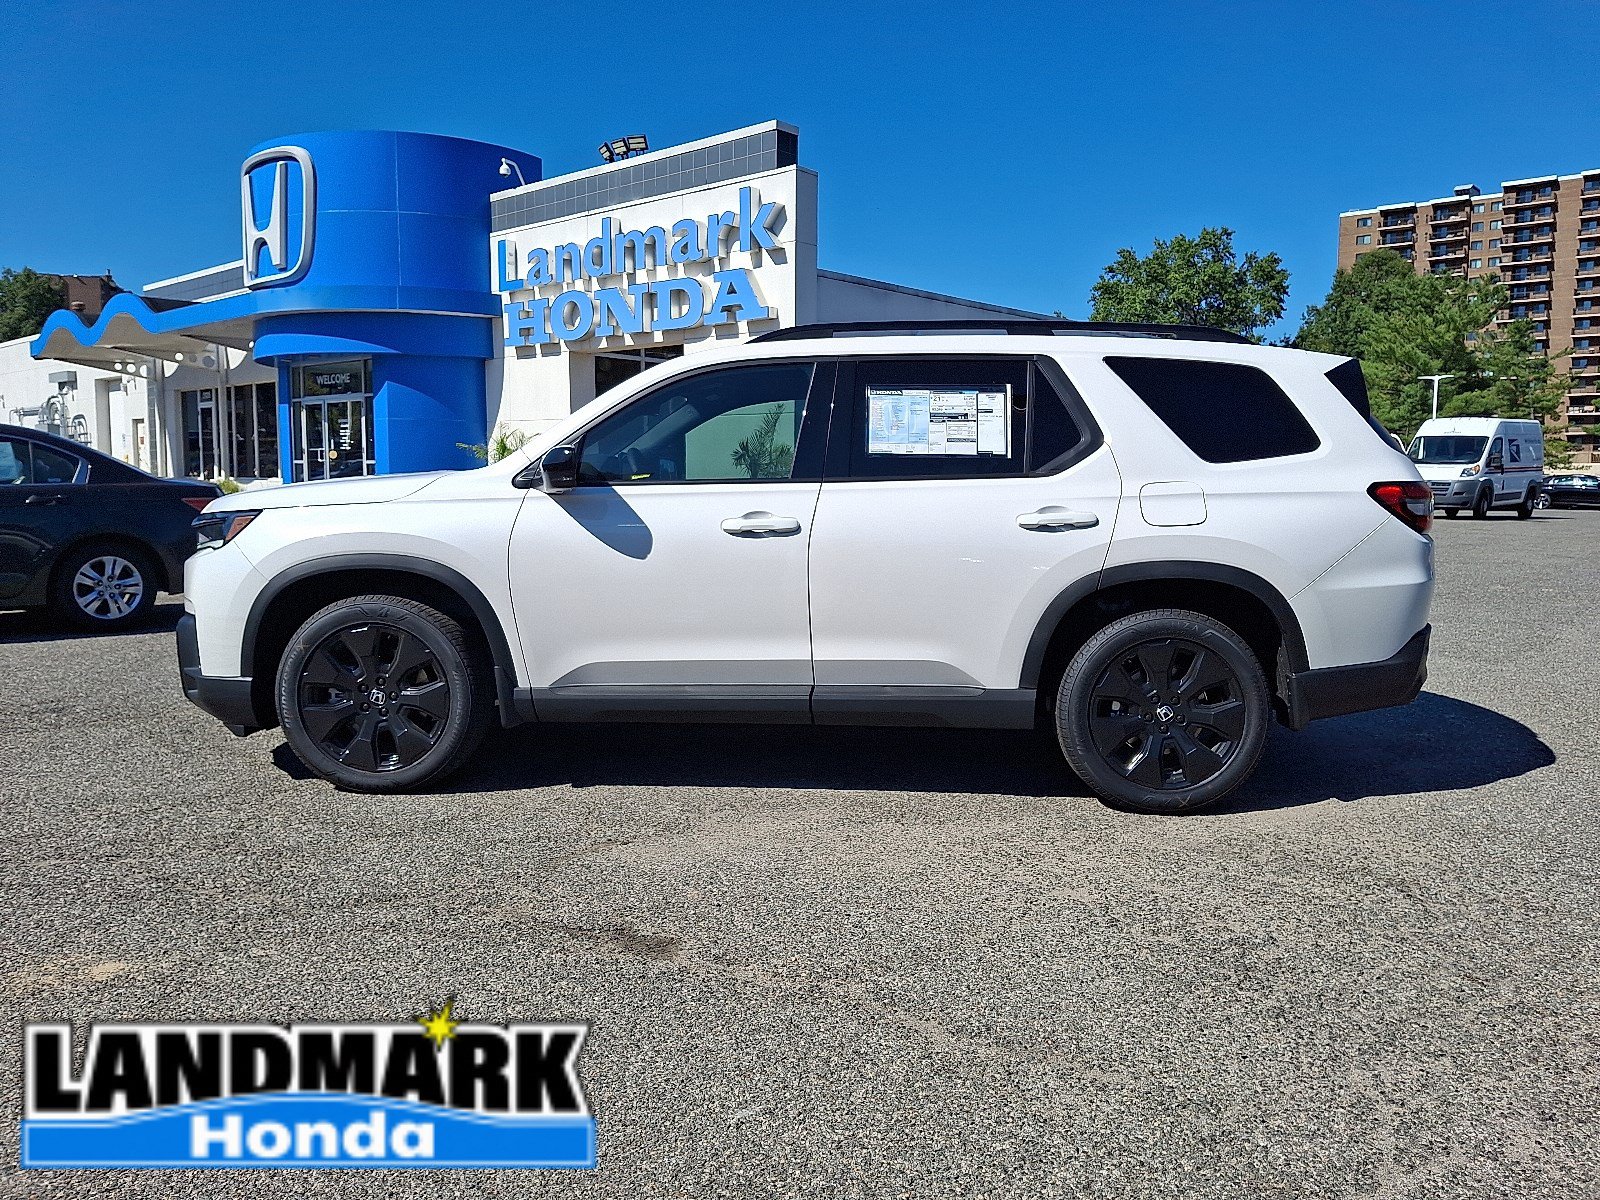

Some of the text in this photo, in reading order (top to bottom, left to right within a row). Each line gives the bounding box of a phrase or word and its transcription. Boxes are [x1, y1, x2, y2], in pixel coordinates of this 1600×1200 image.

[498, 186, 776, 292] Landmark
[504, 268, 770, 347] HONDA
[316, 372, 350, 385] WELCOME
